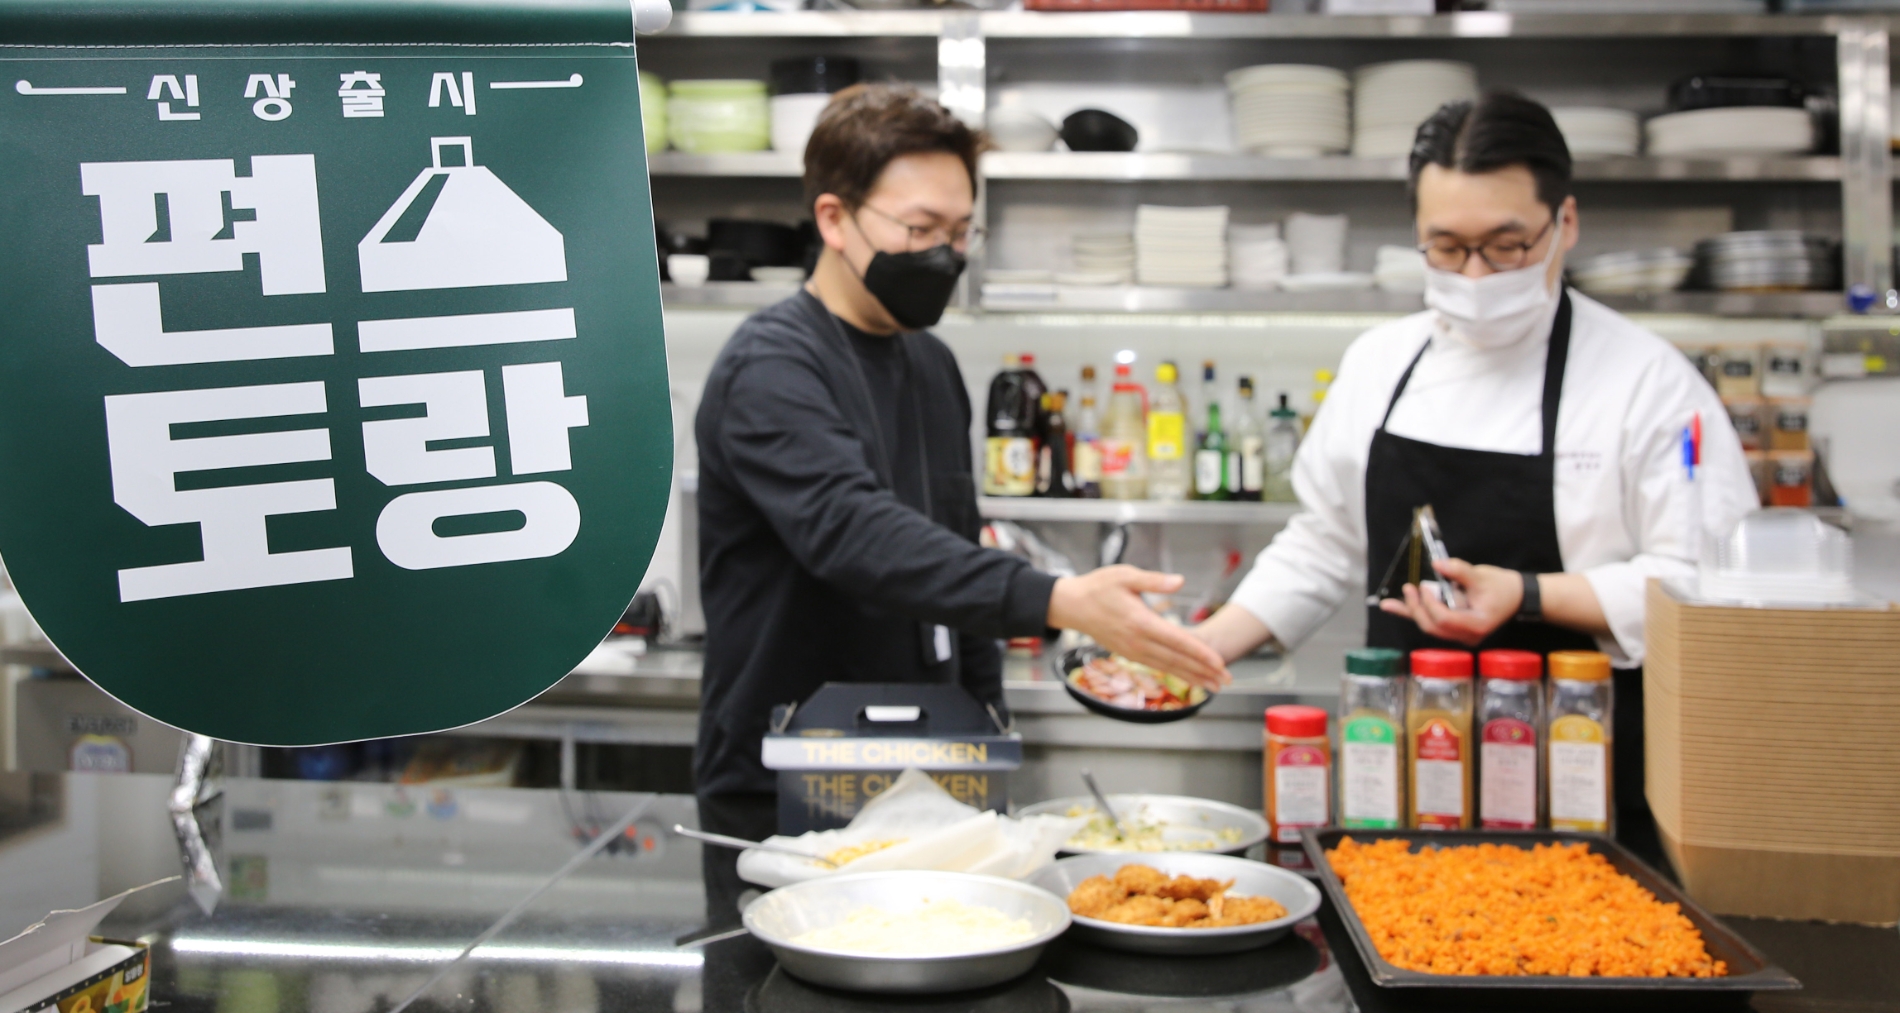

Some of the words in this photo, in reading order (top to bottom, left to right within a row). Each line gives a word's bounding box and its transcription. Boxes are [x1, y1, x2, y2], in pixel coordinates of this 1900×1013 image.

[147, 71, 477, 122] 신상출시
[105, 361, 589, 602] 토랑
[802, 742, 857, 764] THE
[861, 742, 988, 764] CHICKEN
[802, 773, 857, 797] THE
